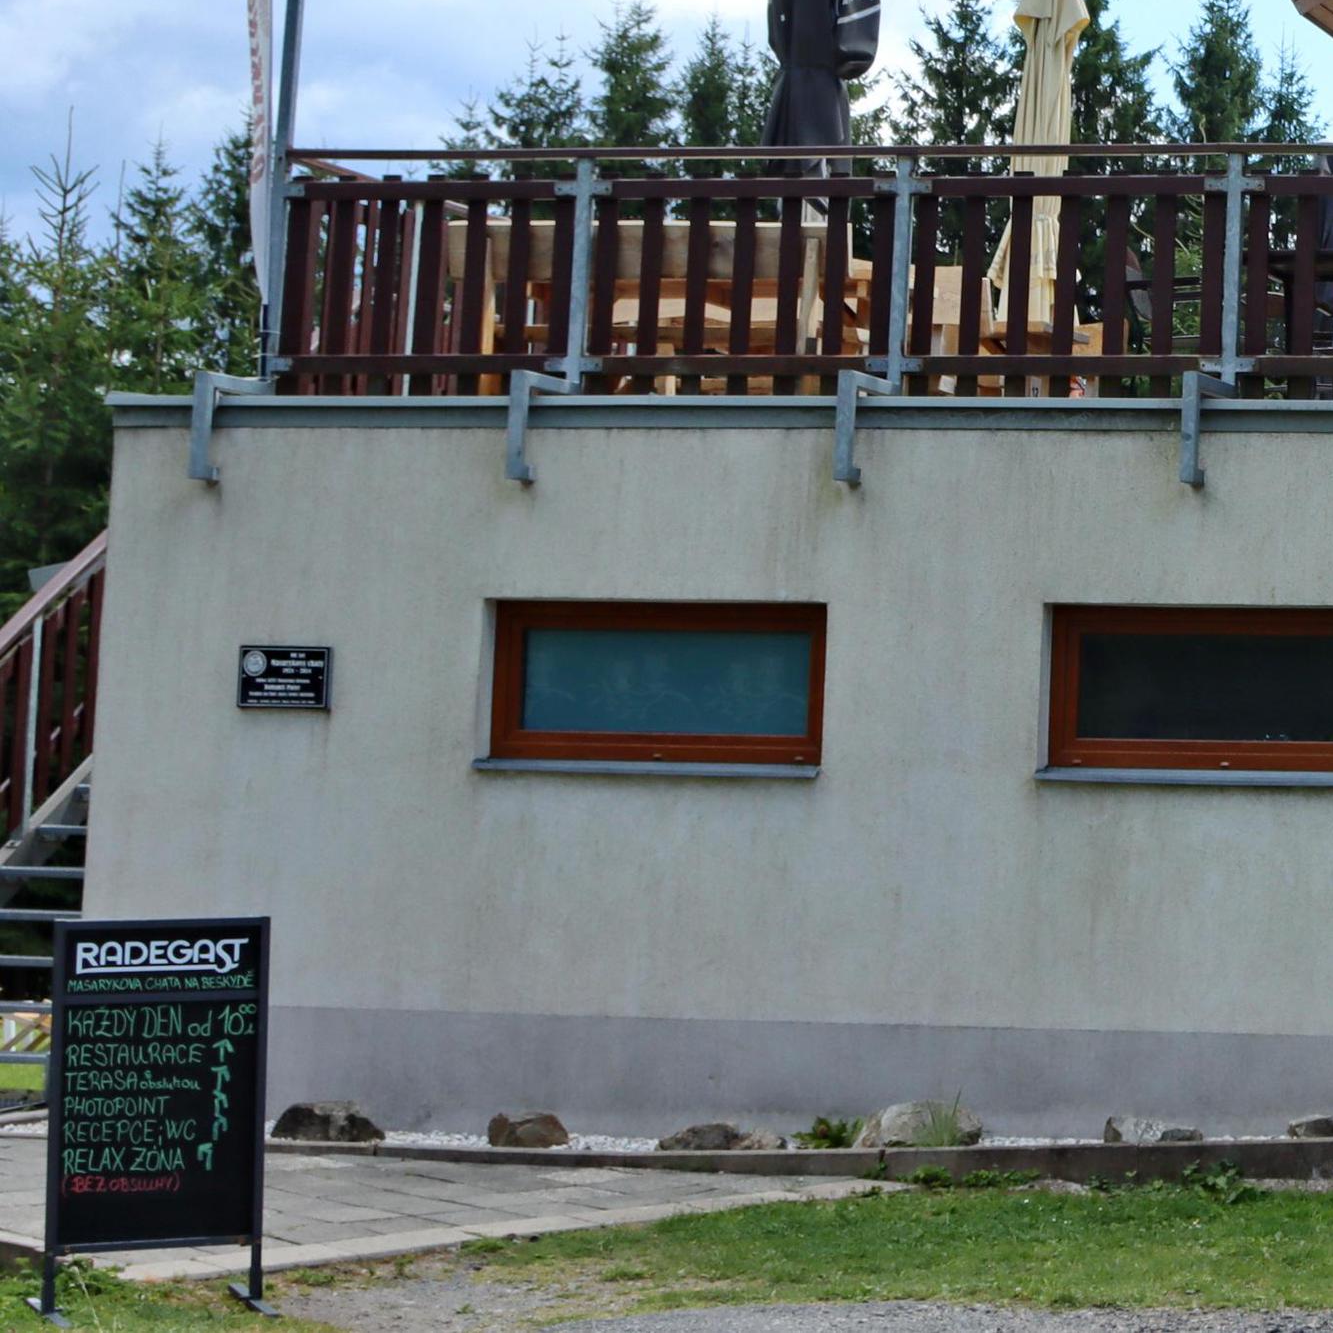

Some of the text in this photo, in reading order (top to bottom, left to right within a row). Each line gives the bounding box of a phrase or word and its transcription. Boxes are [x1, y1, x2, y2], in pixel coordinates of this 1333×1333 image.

[76, 938, 249, 975] RADEGAST
[67, 977, 142, 993] MASARYKOVA
[145, 976, 181, 991] CHATA
[184, 976, 199, 990] NA
[142, 1004, 182, 1038] DEN
[187, 1009, 212, 1037] od
[65, 1041, 206, 1067] RESTAURACE
[65, 1070, 138, 1092] TERASA
[64, 1095, 170, 1116] PHOTOPOINT
[165, 1118, 197, 1141] WC
[62, 1147, 126, 1175] RELAX
